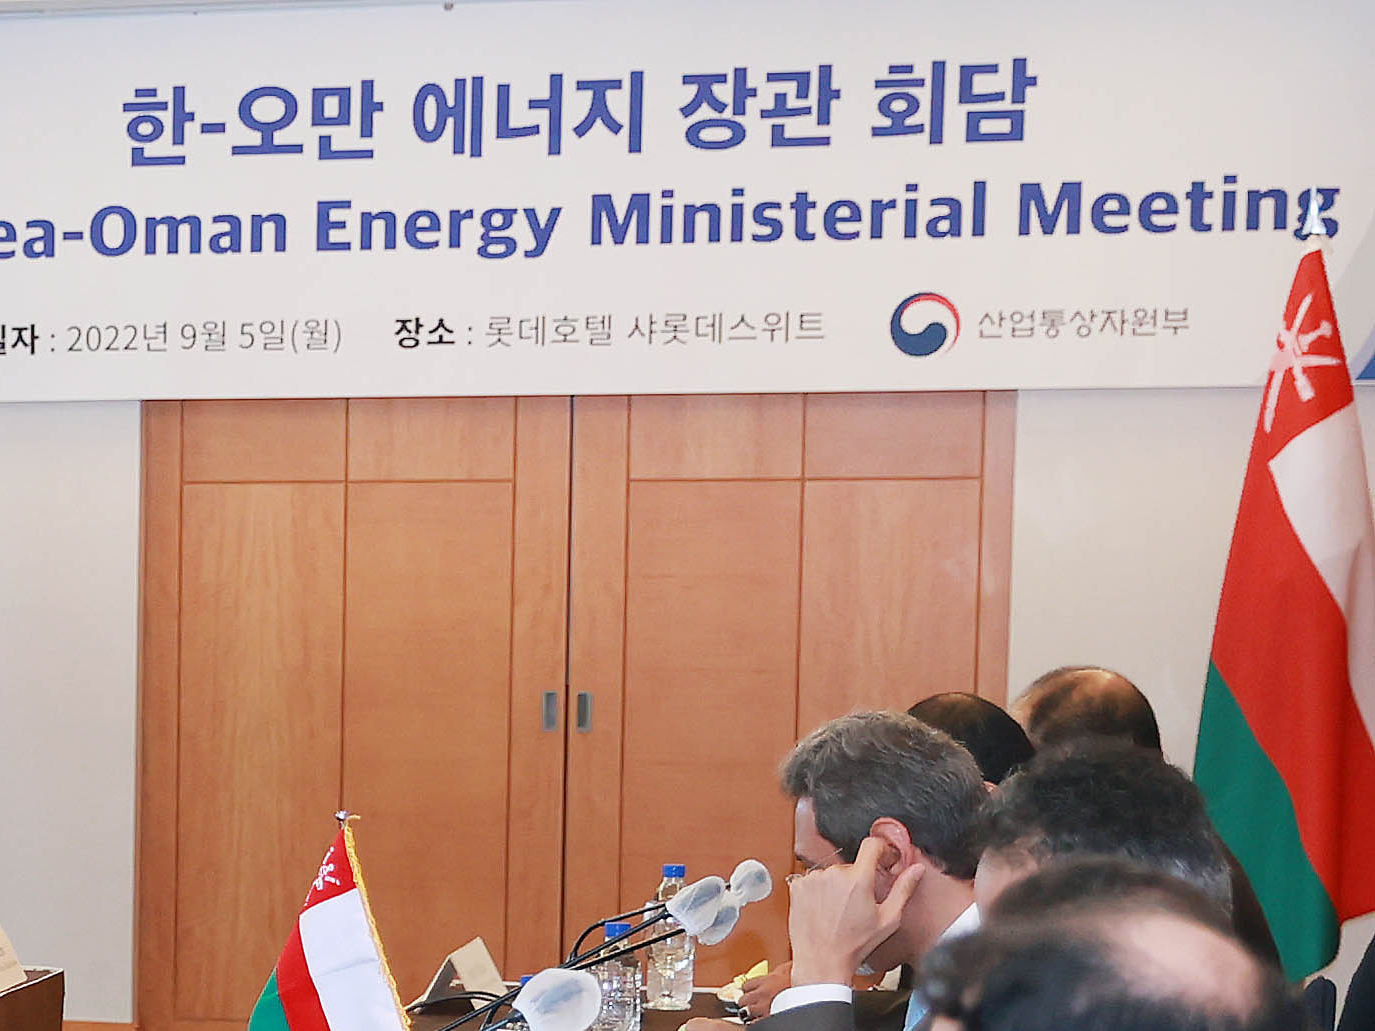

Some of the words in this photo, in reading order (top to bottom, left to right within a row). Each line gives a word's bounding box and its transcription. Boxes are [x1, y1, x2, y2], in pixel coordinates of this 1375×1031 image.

[122, 79, 384, 167] 한-오만
[412, 71, 645, 158] 에너지
[679, 64, 841, 150] 장관
[871, 57, 1038, 145] 회담
[316, 200, 563, 259] Energy
[590, 180, 987, 246] Ministerial
[1017, 174, 1341, 242] Meeting
[66, 321, 169, 353] 2022년
[180, 319, 227, 352] 9월
[238, 318, 342, 353] 5일(월)
[393, 316, 455, 348] 장소
[485, 313, 614, 348] 롯데호텔
[627, 311, 826, 345] 샤롯데스위트
[976, 306, 1190, 339] 산업통상자원부
